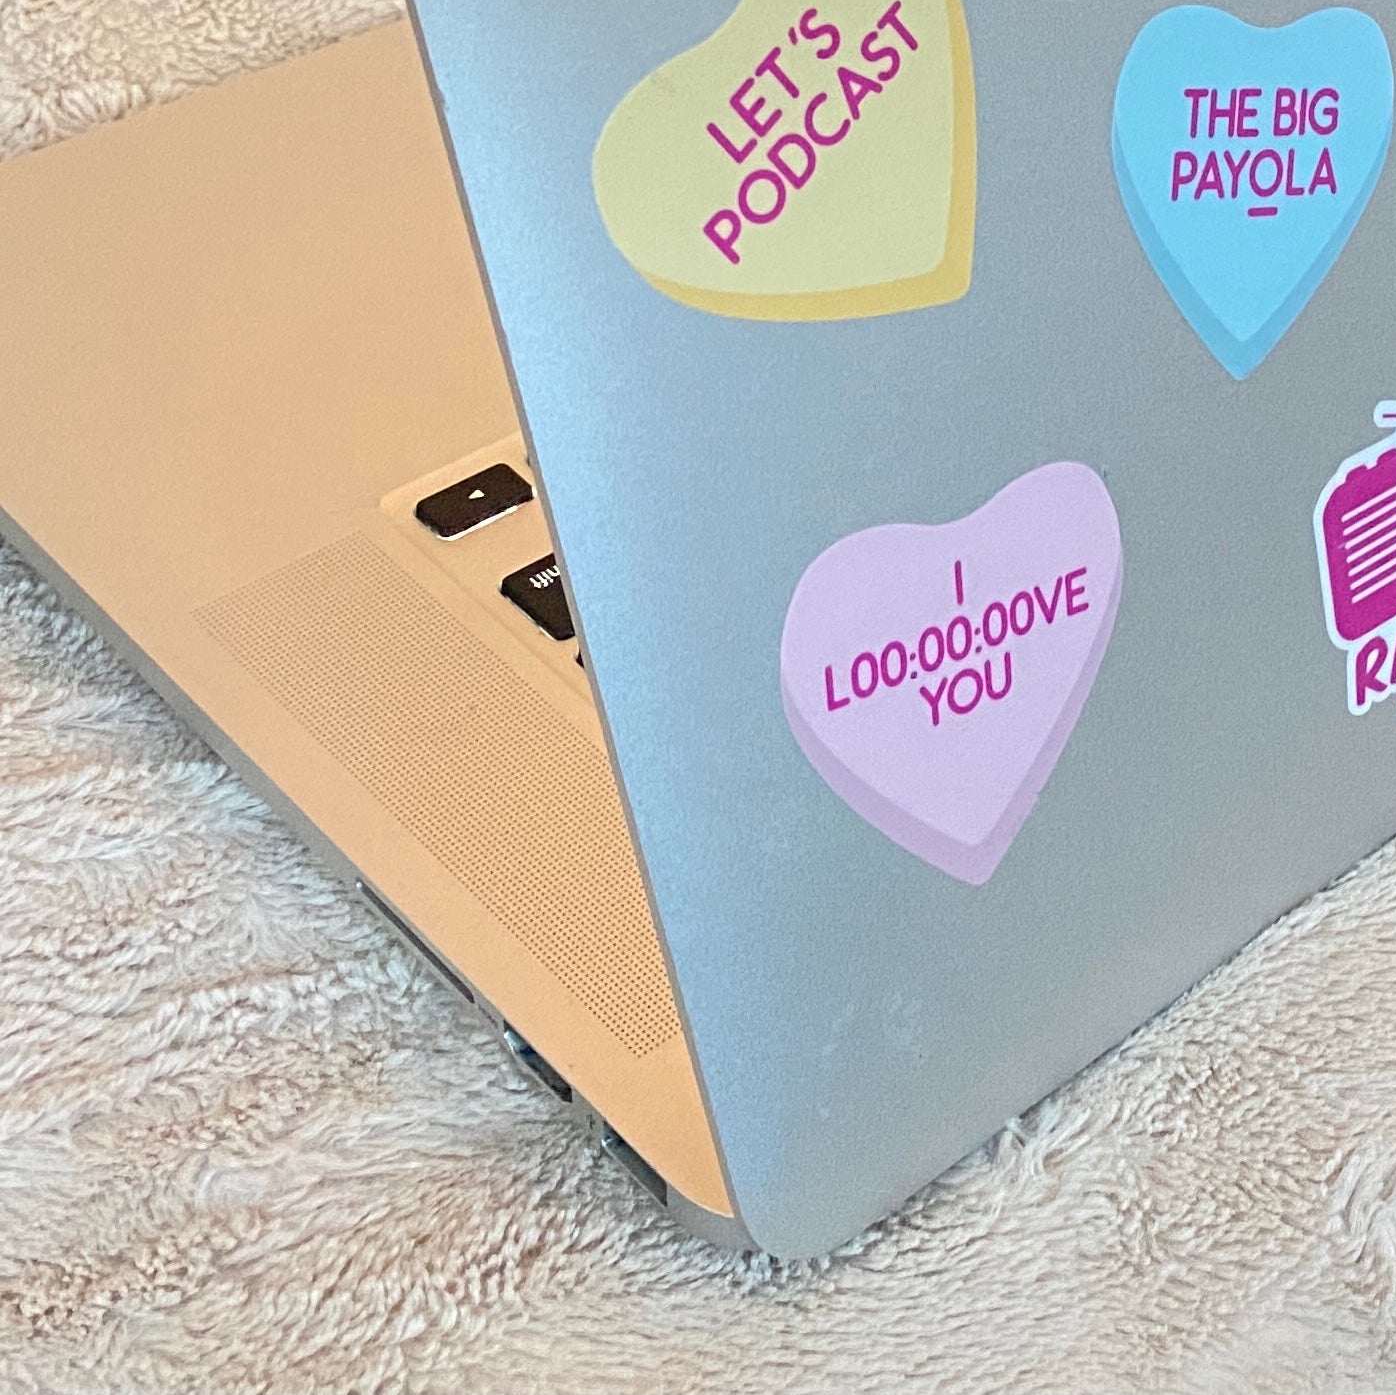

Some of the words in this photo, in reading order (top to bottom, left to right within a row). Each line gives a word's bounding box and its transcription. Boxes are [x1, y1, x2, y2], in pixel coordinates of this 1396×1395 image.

[705, 7, 842, 164] LET'S
[1184, 87, 1262, 138] THE
[1272, 87, 1340, 136] BIG
[701, 0, 920, 265] PODCAST
[1170, 150, 1338, 218] PAYOLA
[953, 560, 966, 606] I
[918, 650, 1014, 727] YOU
